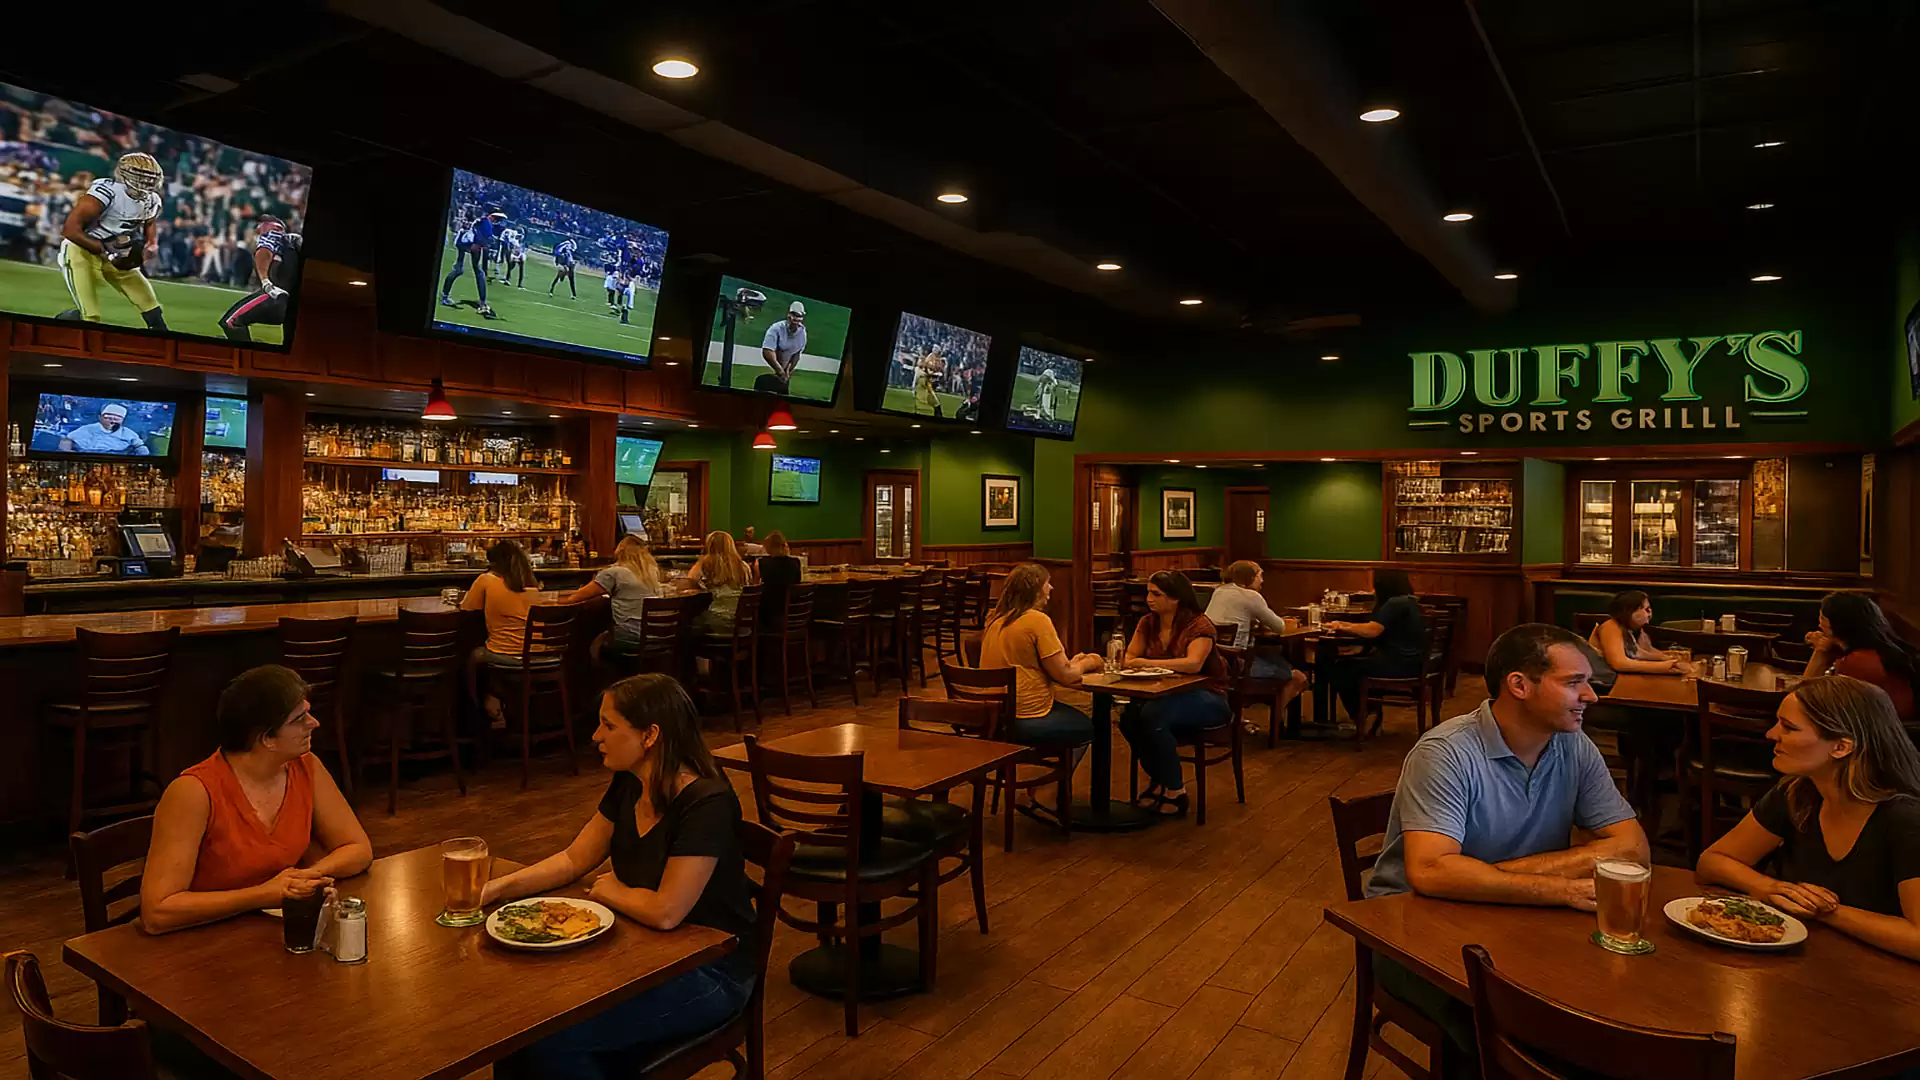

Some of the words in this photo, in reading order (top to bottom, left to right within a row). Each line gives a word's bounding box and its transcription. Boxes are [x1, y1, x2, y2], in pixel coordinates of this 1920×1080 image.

[1407, 330, 1810, 411] DUFFY'S
[1459, 409, 1592, 433] SPORTS
[1611, 406, 1740, 429] GRILLL
